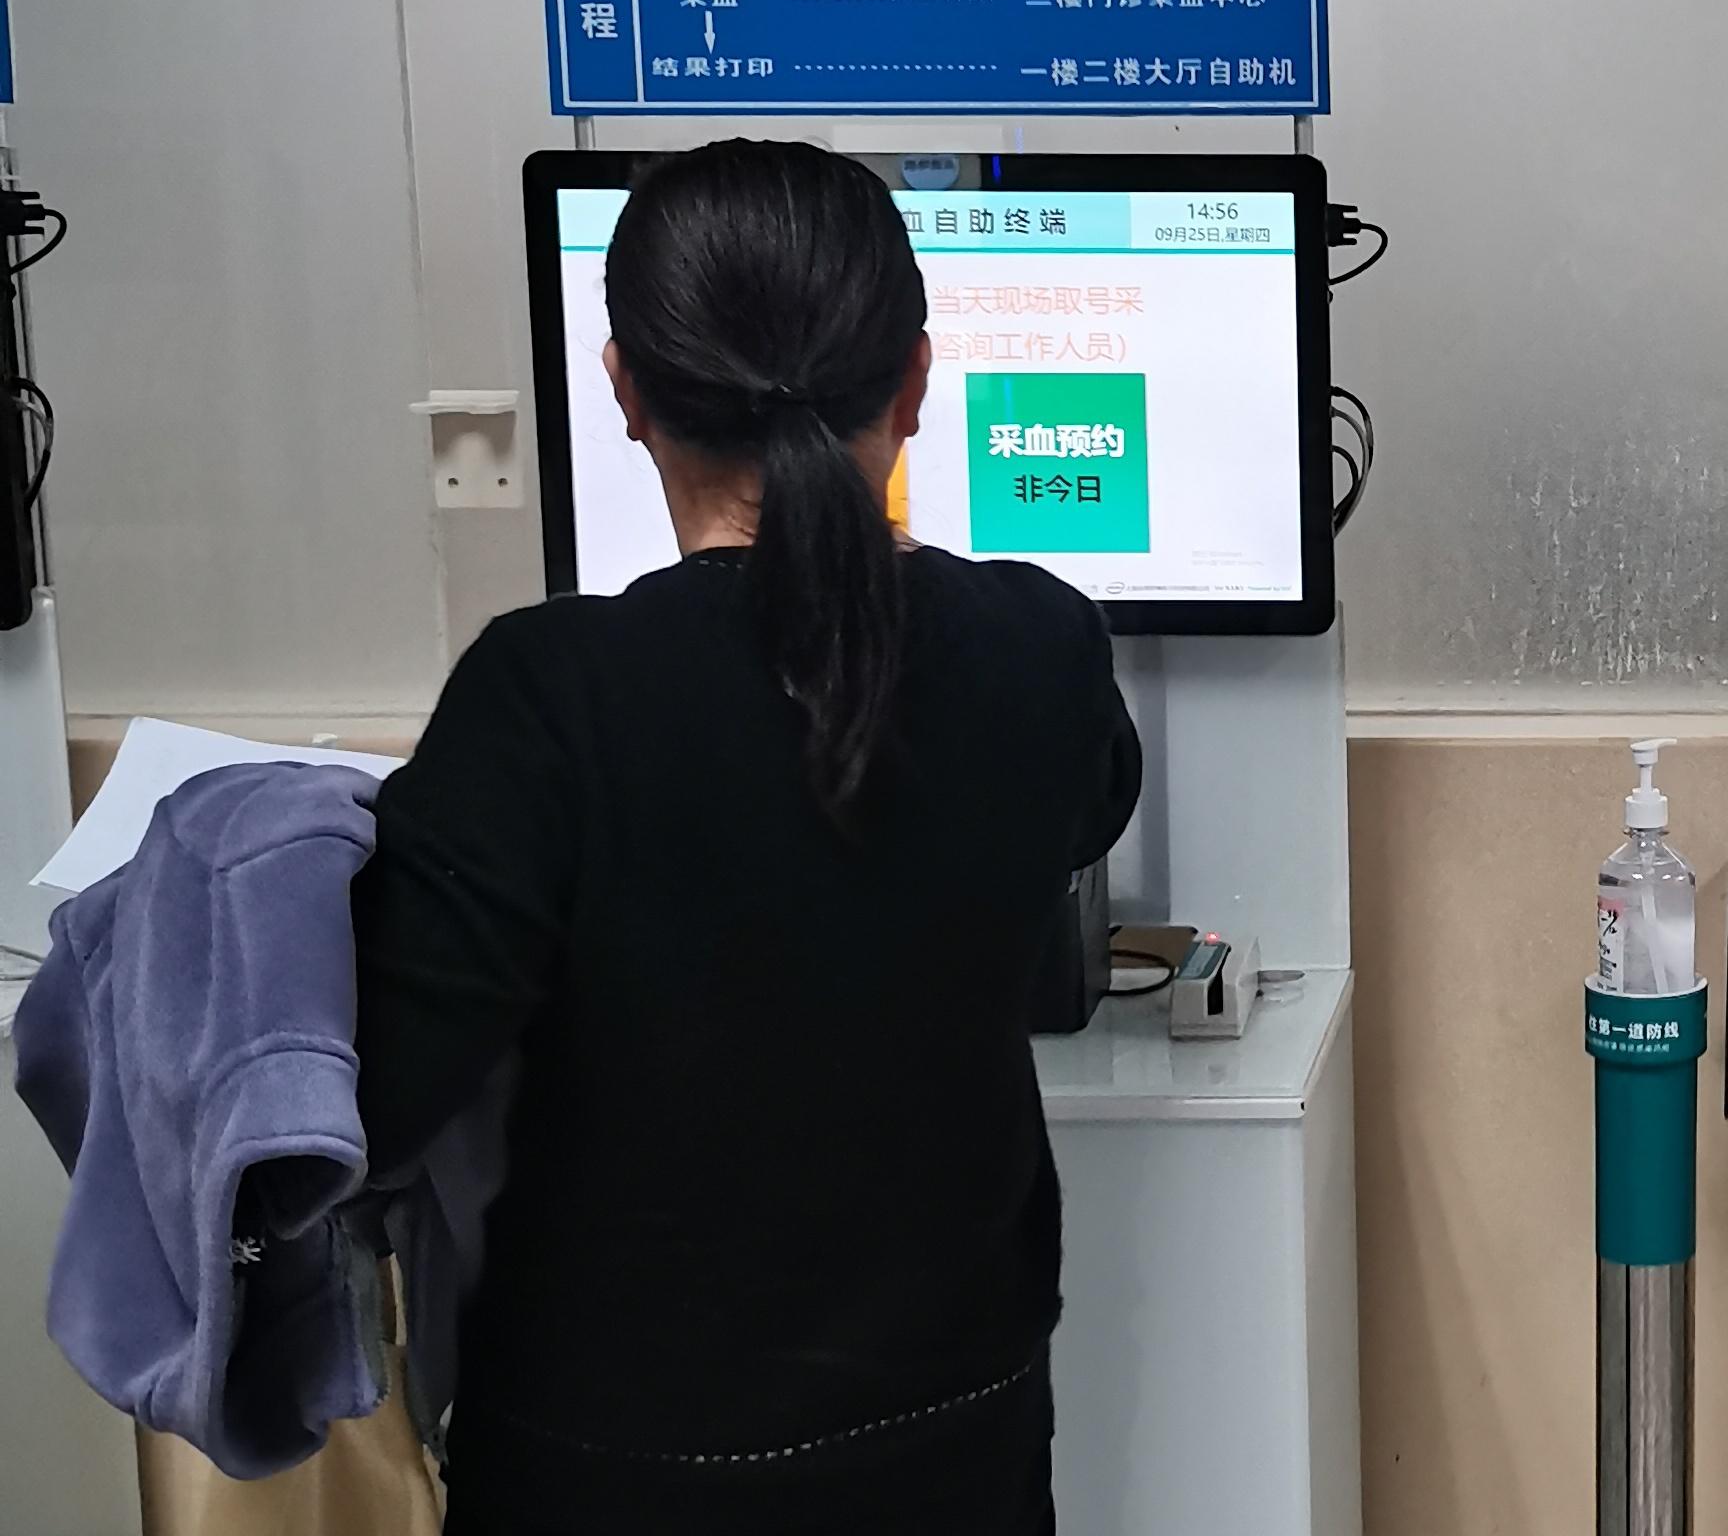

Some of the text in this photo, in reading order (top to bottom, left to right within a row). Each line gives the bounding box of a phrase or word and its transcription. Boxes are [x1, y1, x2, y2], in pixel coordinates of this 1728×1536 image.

[653, 57, 1296, 86] 结果打印 一楼二楼大厅自助机
[1188, 203, 1238, 219] 14:56
[989, 424, 1124, 458] 采血预约
[1014, 475, 1100, 503] 非今日
